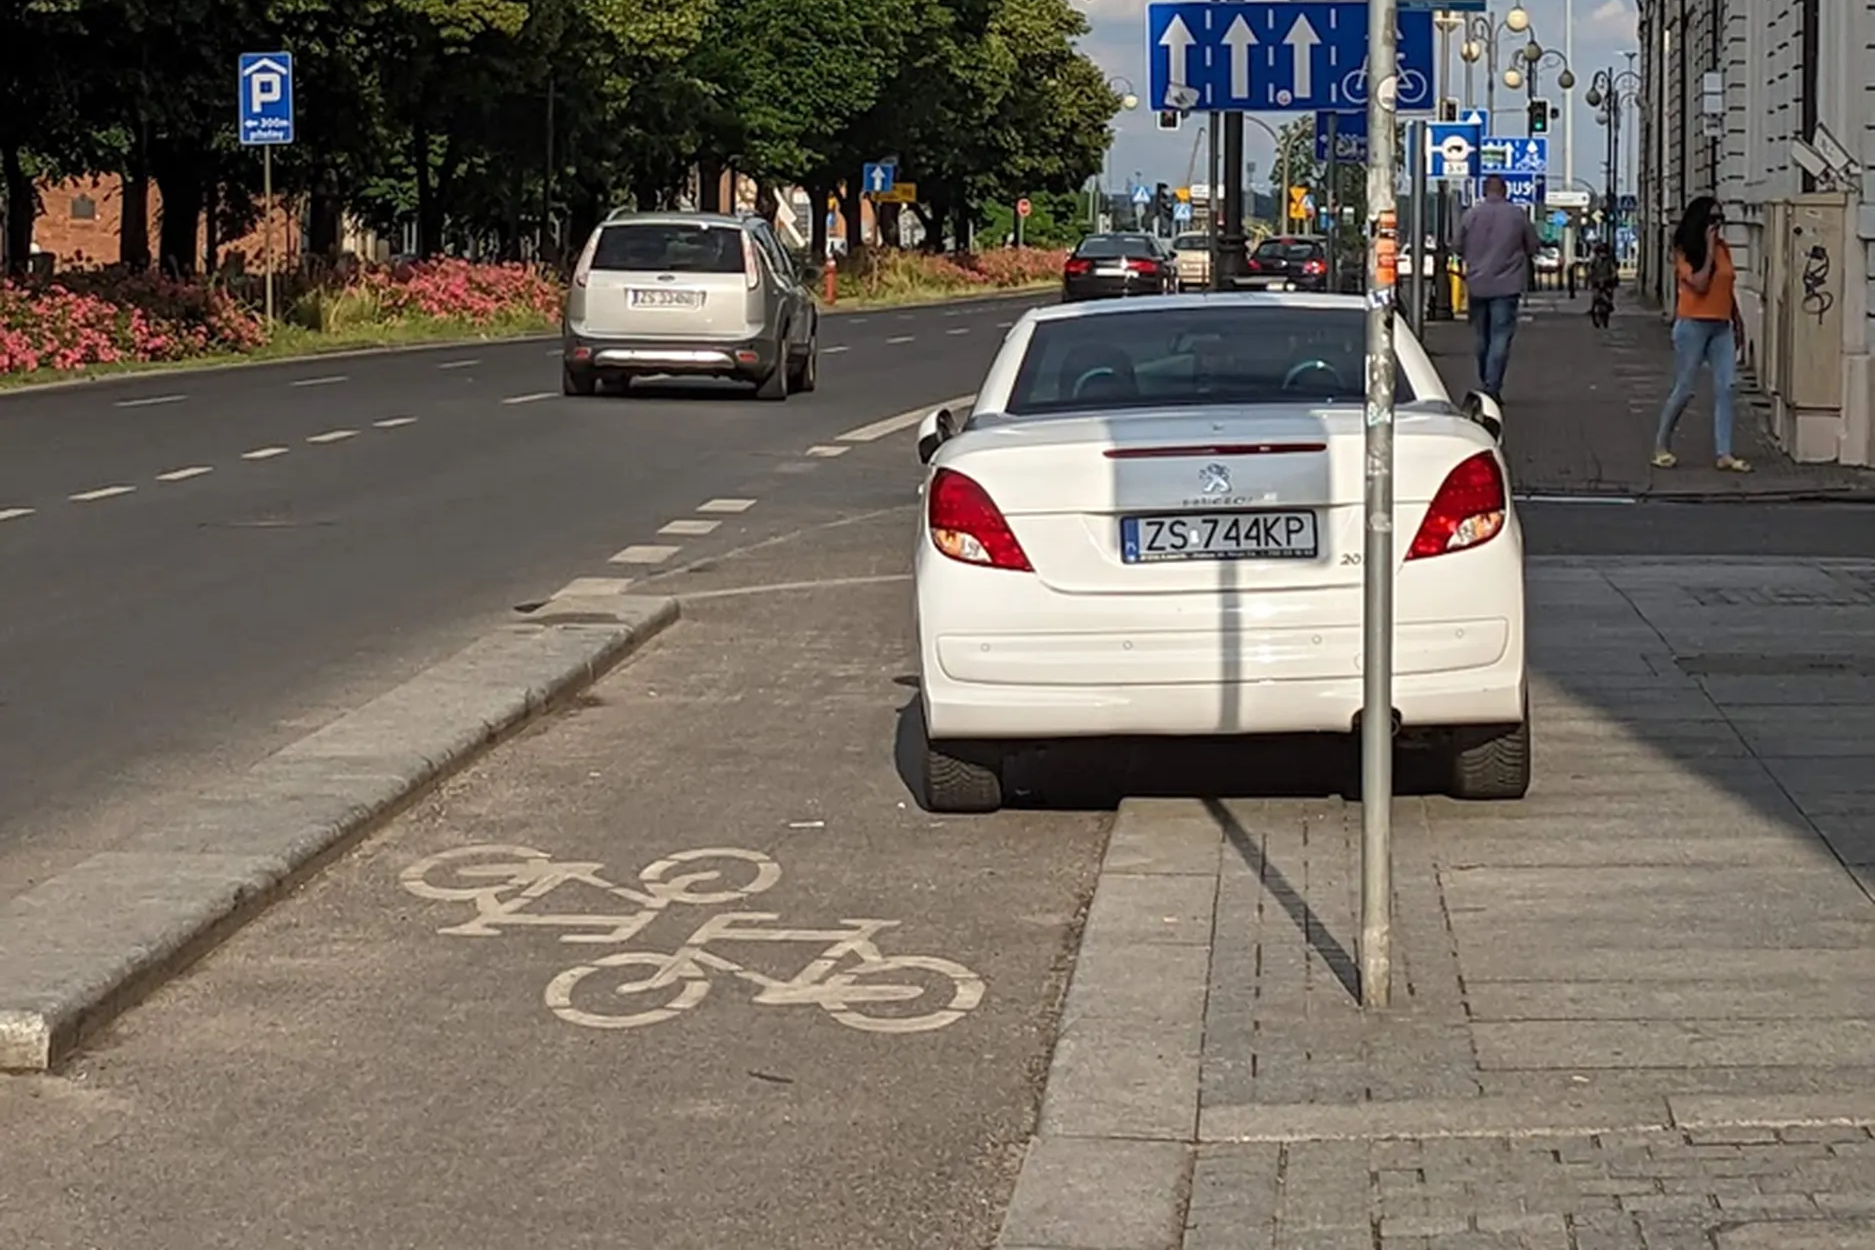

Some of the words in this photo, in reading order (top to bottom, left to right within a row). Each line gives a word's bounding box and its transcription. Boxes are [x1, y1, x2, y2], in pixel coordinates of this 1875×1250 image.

[251, 72, 282, 113] P
[1145, 520, 1189, 552] ZS
[1201, 516, 1306, 549] 744KP
[1340, 553, 1364, 566] 20
